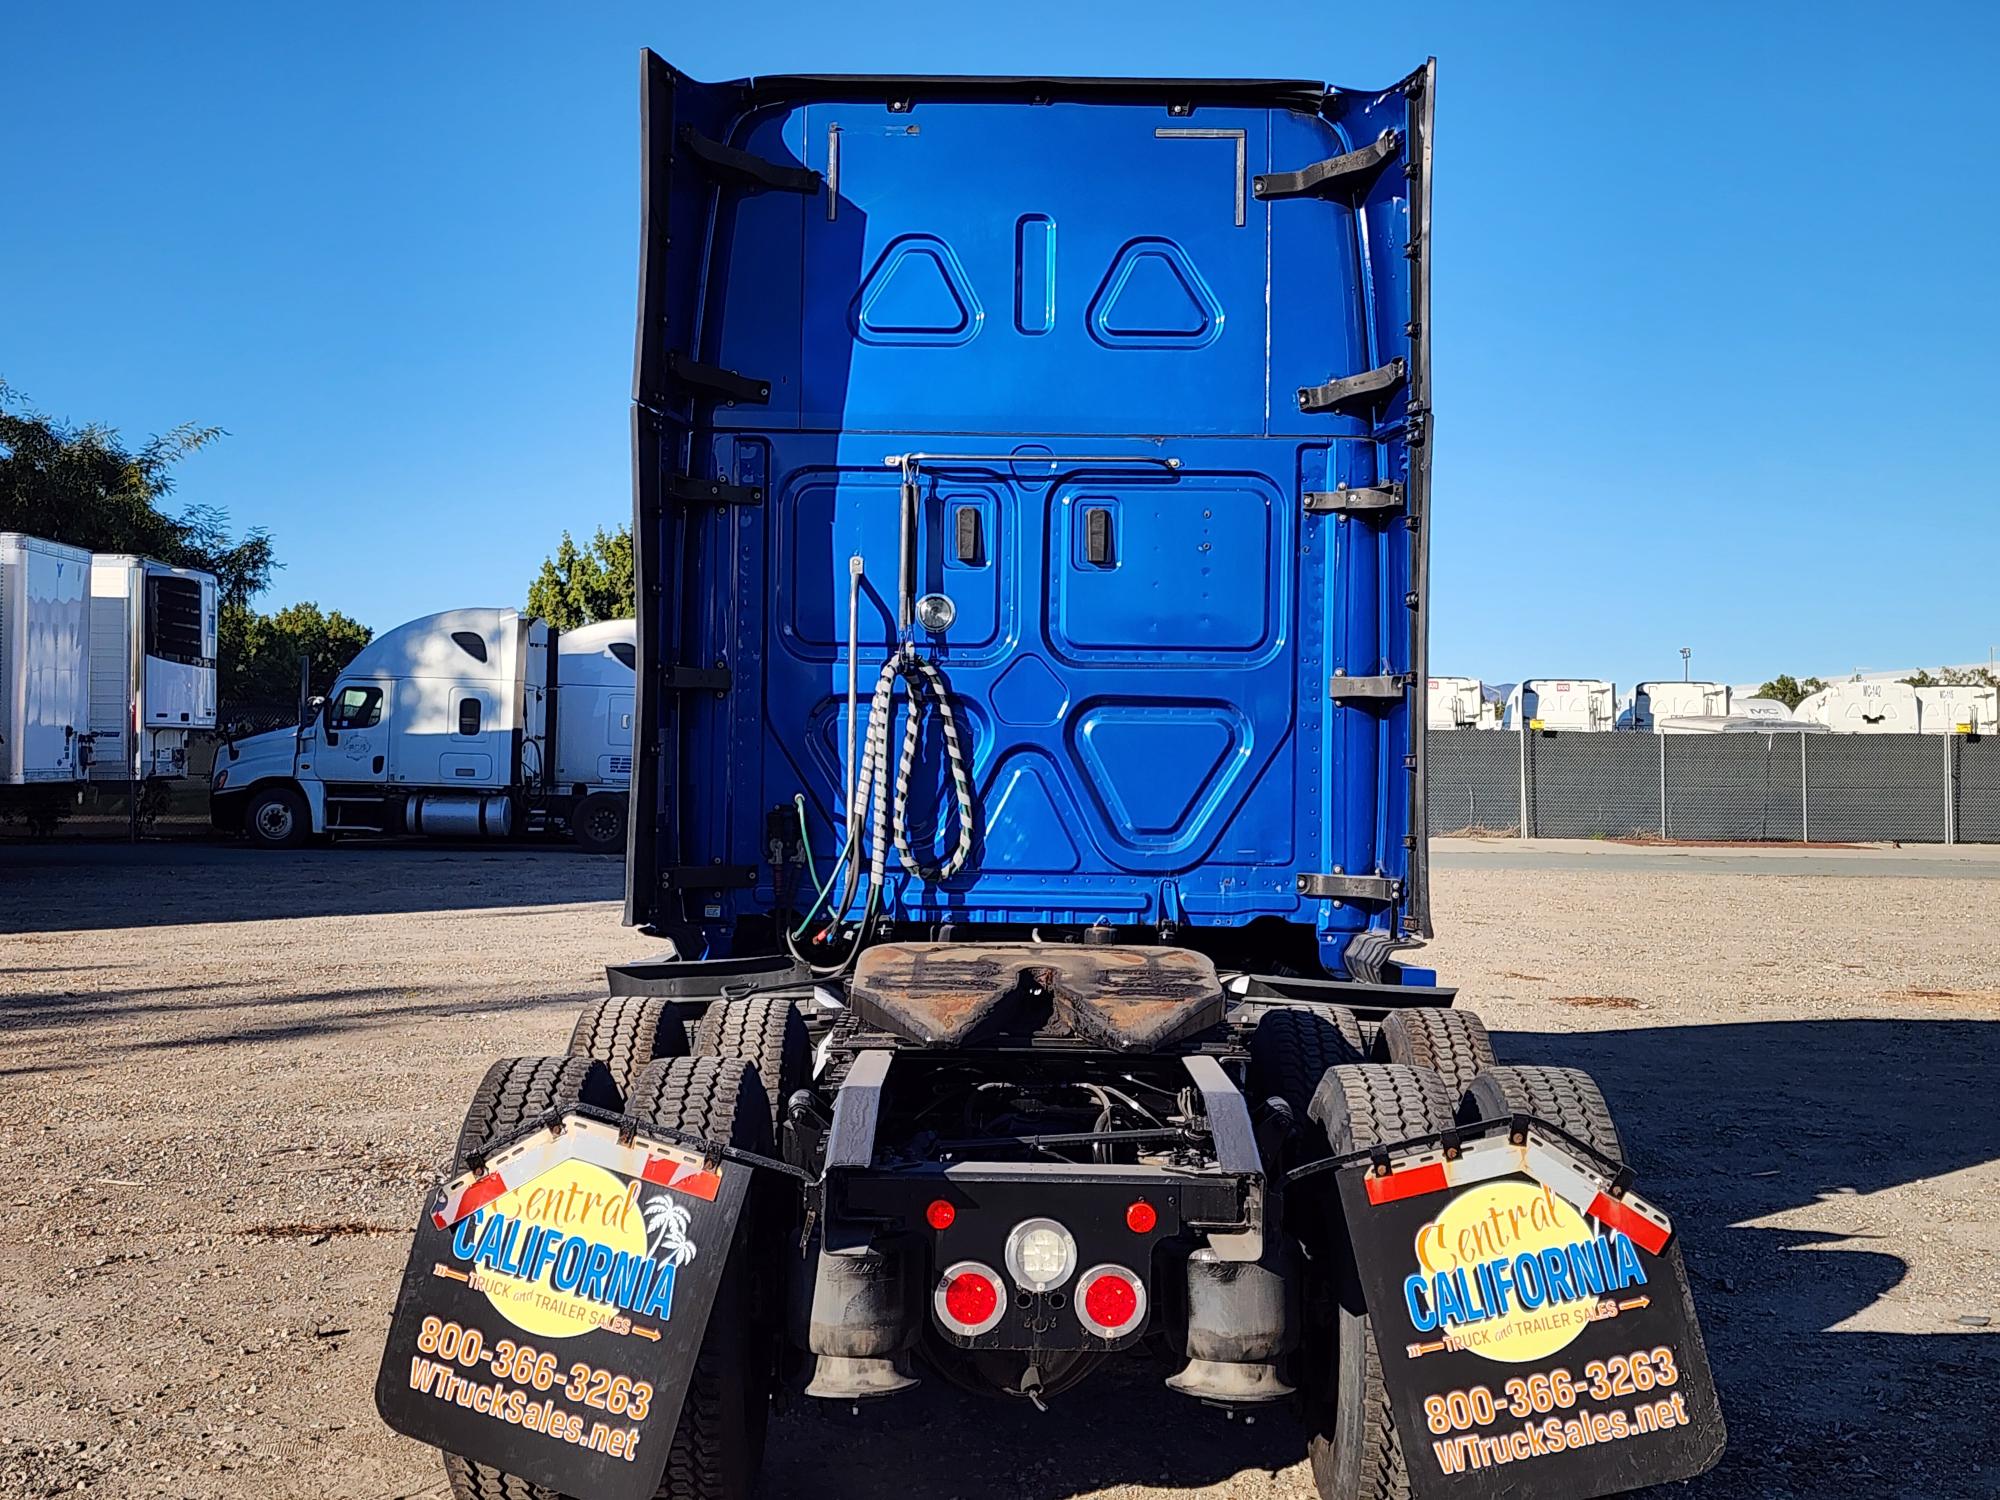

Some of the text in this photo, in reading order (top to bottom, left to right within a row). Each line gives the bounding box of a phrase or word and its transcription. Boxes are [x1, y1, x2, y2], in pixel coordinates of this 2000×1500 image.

[452, 1208, 677, 1321] CALIFORNIA
[1415, 1182, 1566, 1276] Central
[467, 1272, 631, 1336] TRUCK and TRAILER SALES
[1404, 1233, 1647, 1332] CALIFORNIA
[1444, 1300, 1618, 1353] TRUCK and TRAILER SALES
[409, 1356, 640, 1462] WTruckSales.net
[417, 1315, 654, 1422] 800-366-3263
[1423, 1346, 1678, 1435] 800-366-3263
[1433, 1391, 1690, 1475] WTruckSales.net
